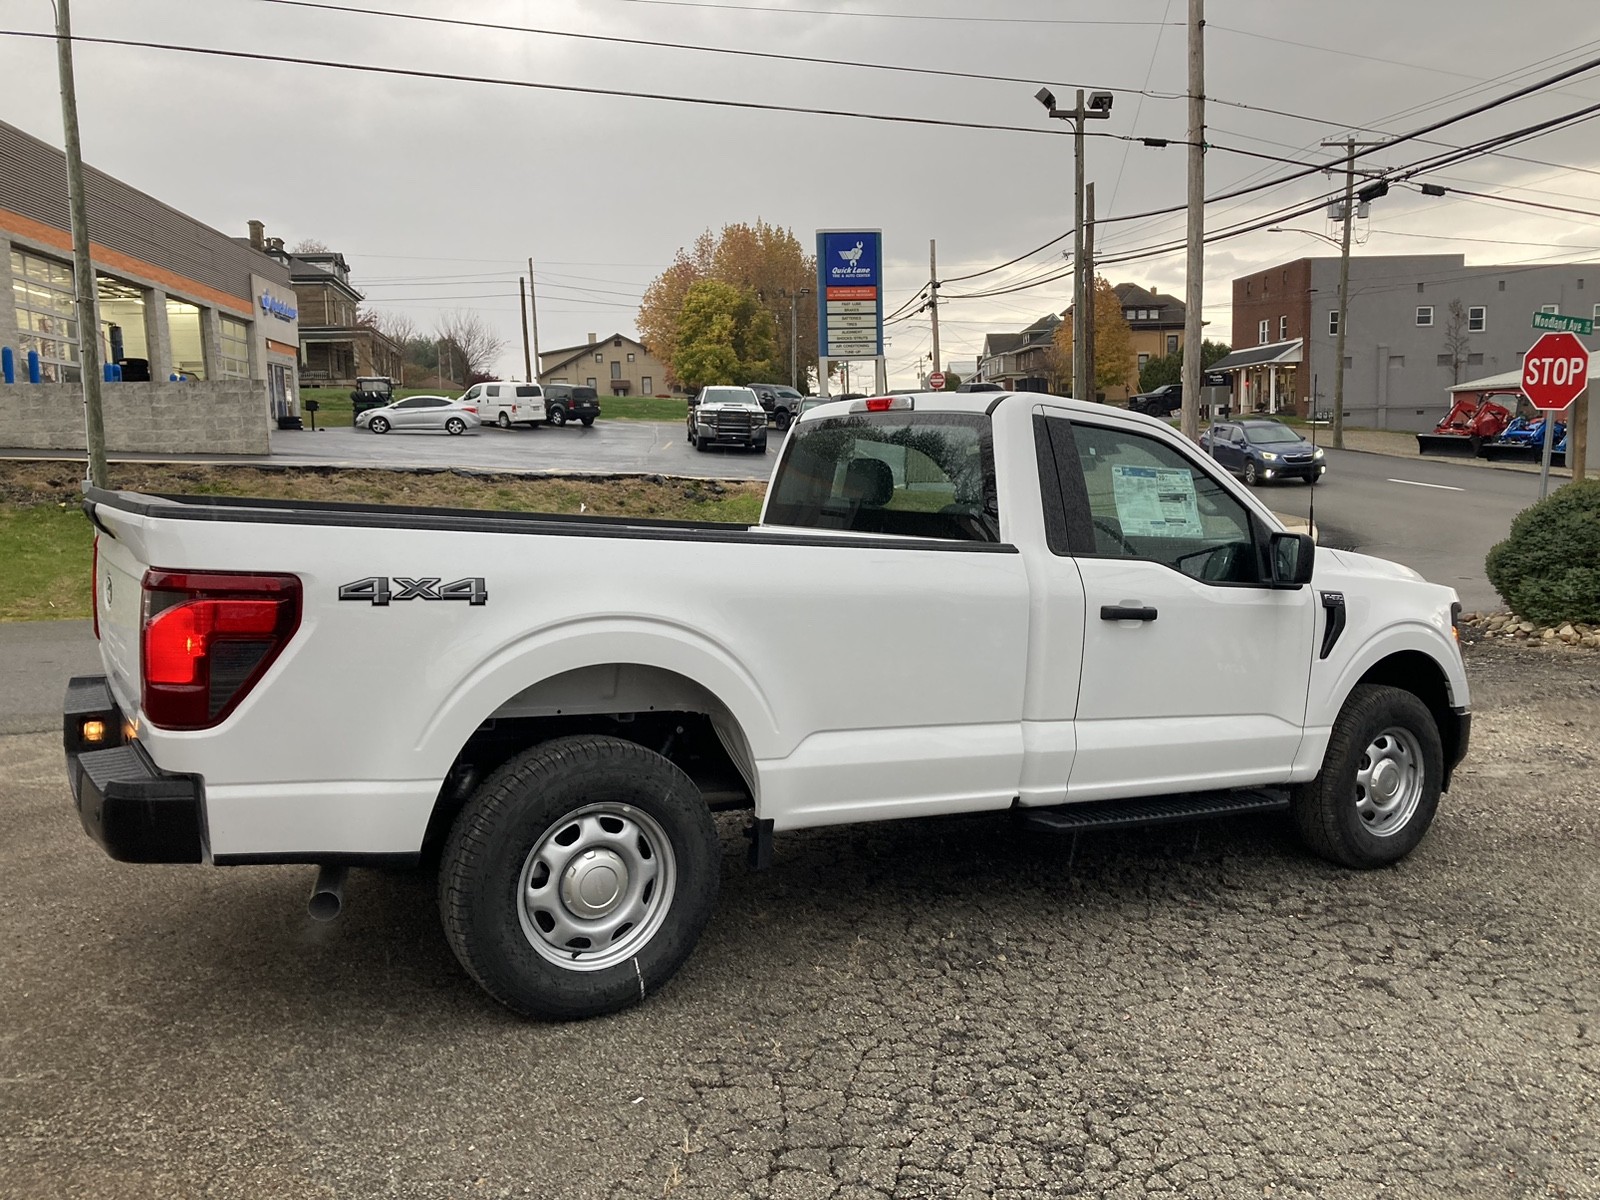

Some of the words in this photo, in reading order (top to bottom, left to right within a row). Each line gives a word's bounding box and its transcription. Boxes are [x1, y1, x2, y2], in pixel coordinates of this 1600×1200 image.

[1535, 314, 1567, 330] Woodland
[1568, 319, 1582, 332] Ave
[1526, 357, 1584, 385] STOP
